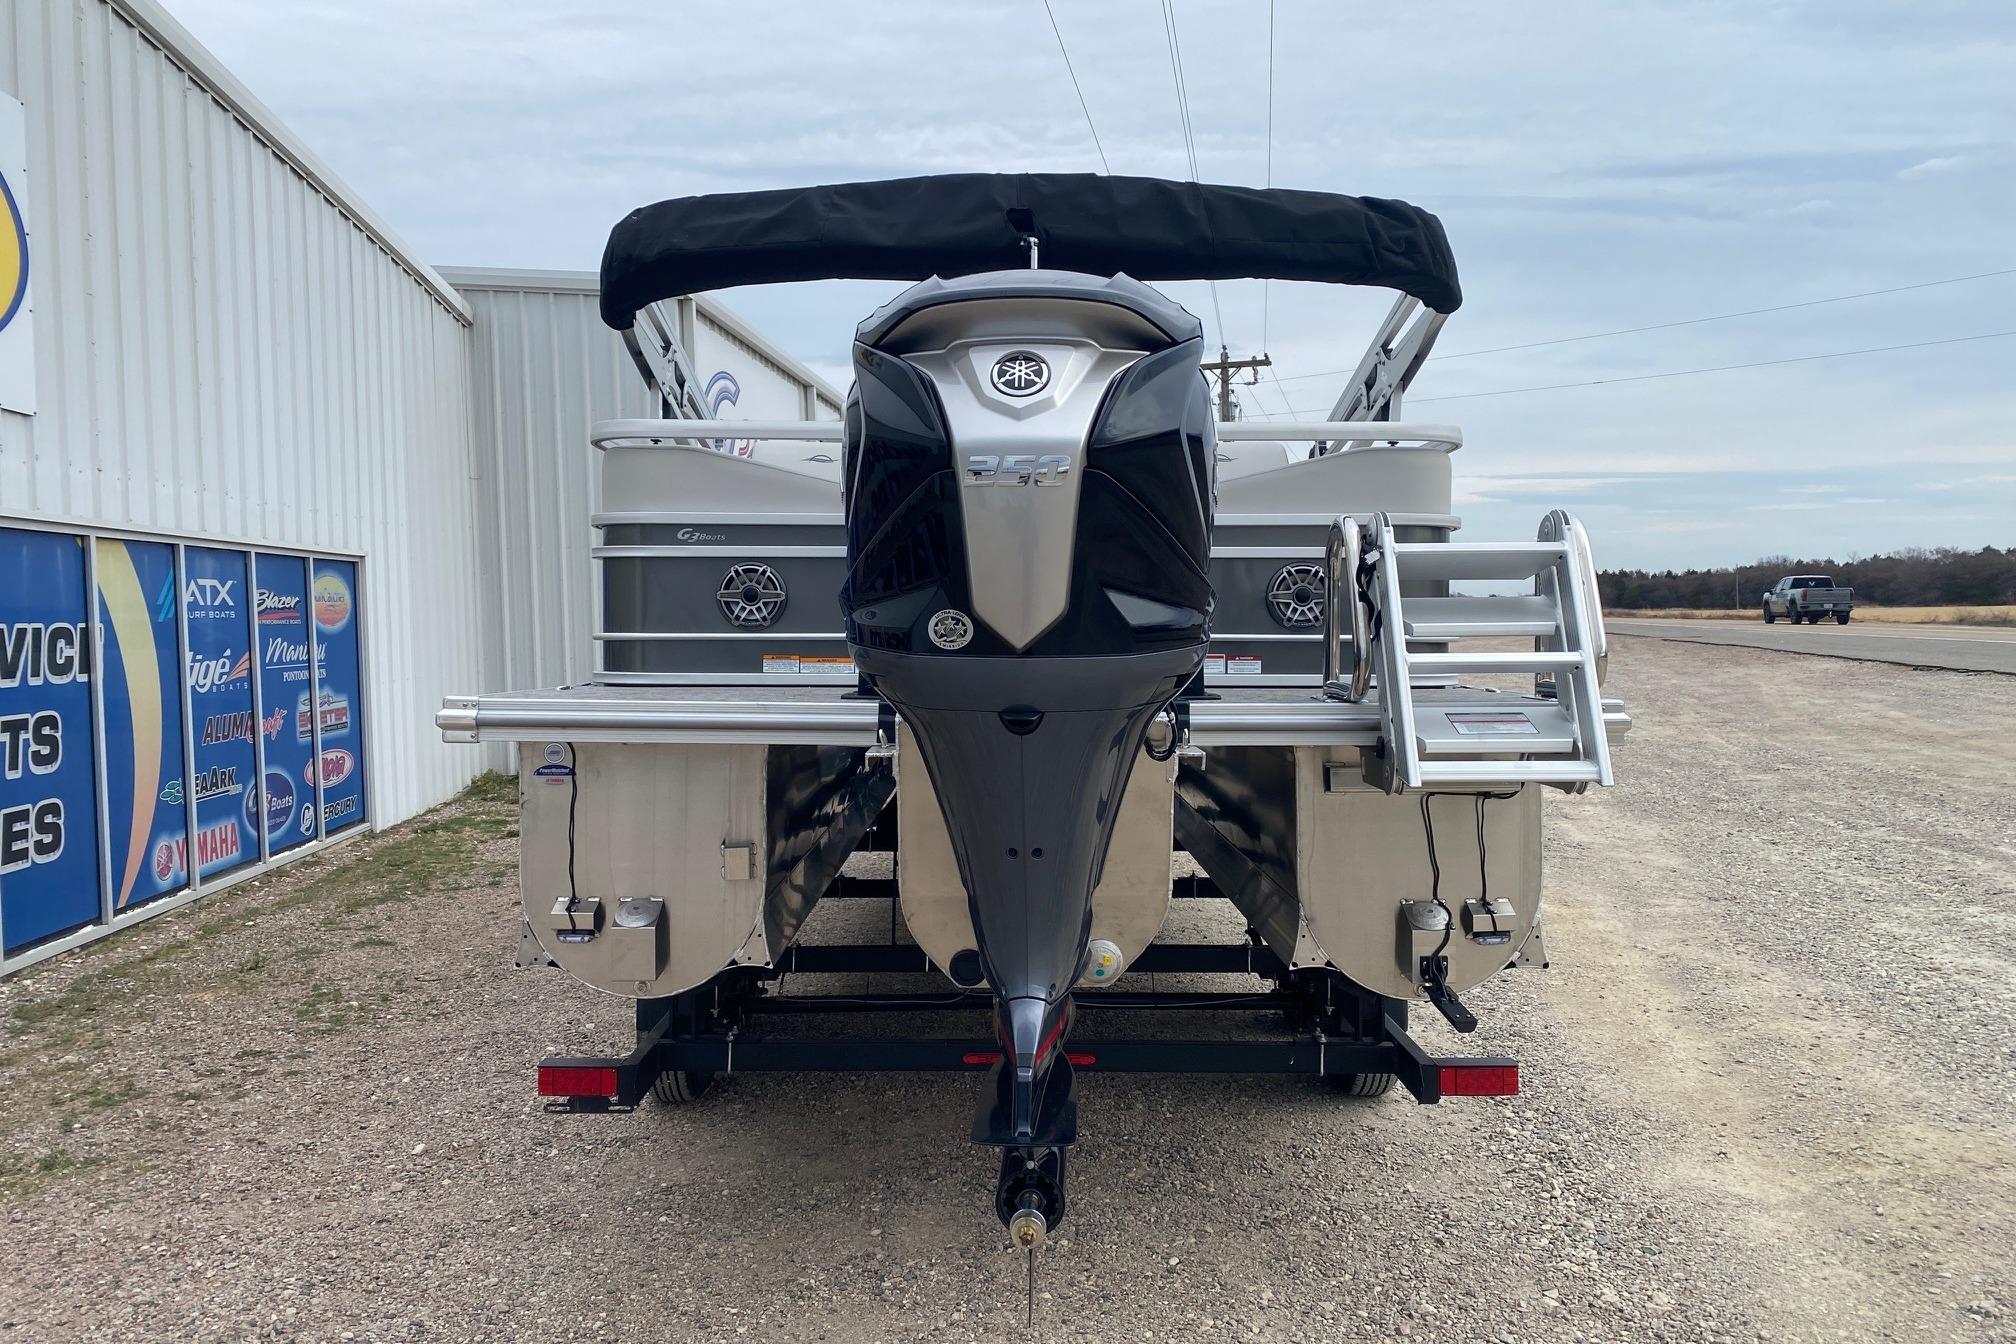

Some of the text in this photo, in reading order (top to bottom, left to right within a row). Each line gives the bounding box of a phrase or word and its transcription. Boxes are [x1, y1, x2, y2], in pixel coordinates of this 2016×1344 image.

[963, 455, 1071, 487] 250
[185, 579, 235, 605] ATX
[256, 588, 300, 613] Blazer
[265, 637, 326, 663] Maniu
[212, 682, 248, 693] BOATS
[270, 796, 293, 811] Boats
[323, 795, 357, 822] ERCURY
[175, 822, 239, 872] YMAHA
